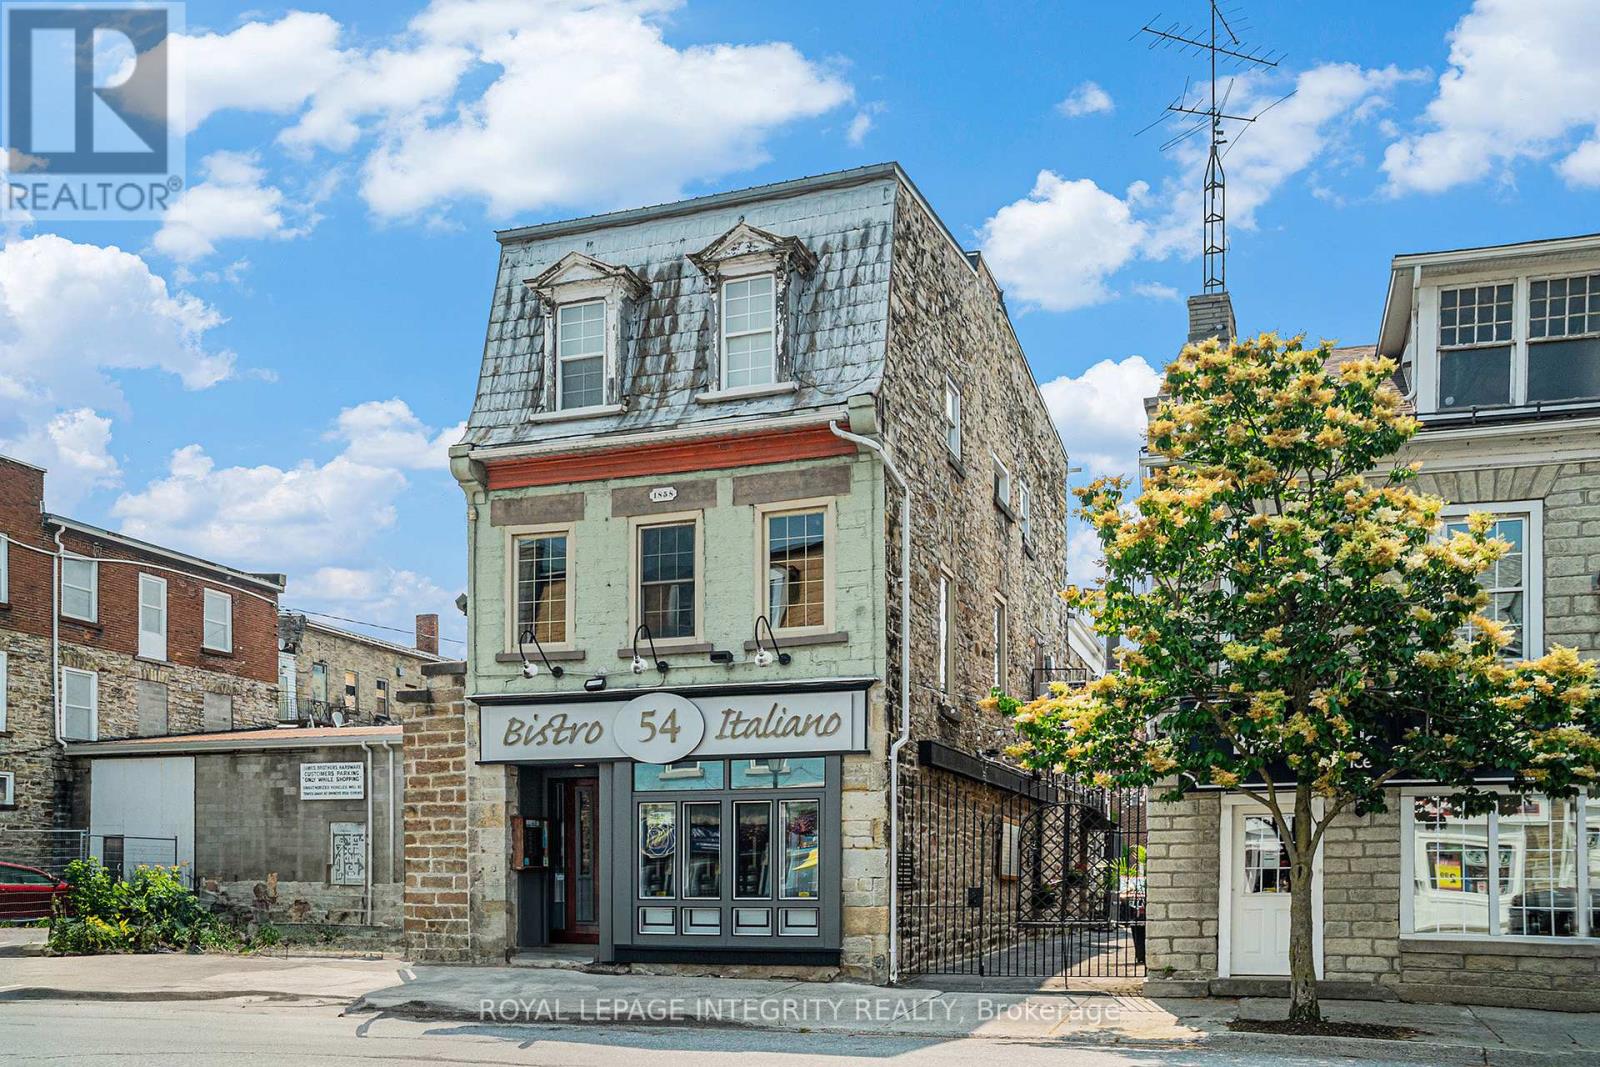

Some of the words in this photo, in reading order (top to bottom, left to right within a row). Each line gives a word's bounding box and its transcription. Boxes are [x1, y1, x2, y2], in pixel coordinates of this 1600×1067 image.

[502, 712, 604, 748] Bistro
[638, 708, 681, 743] 54
[714, 702, 842, 740] Italiano
